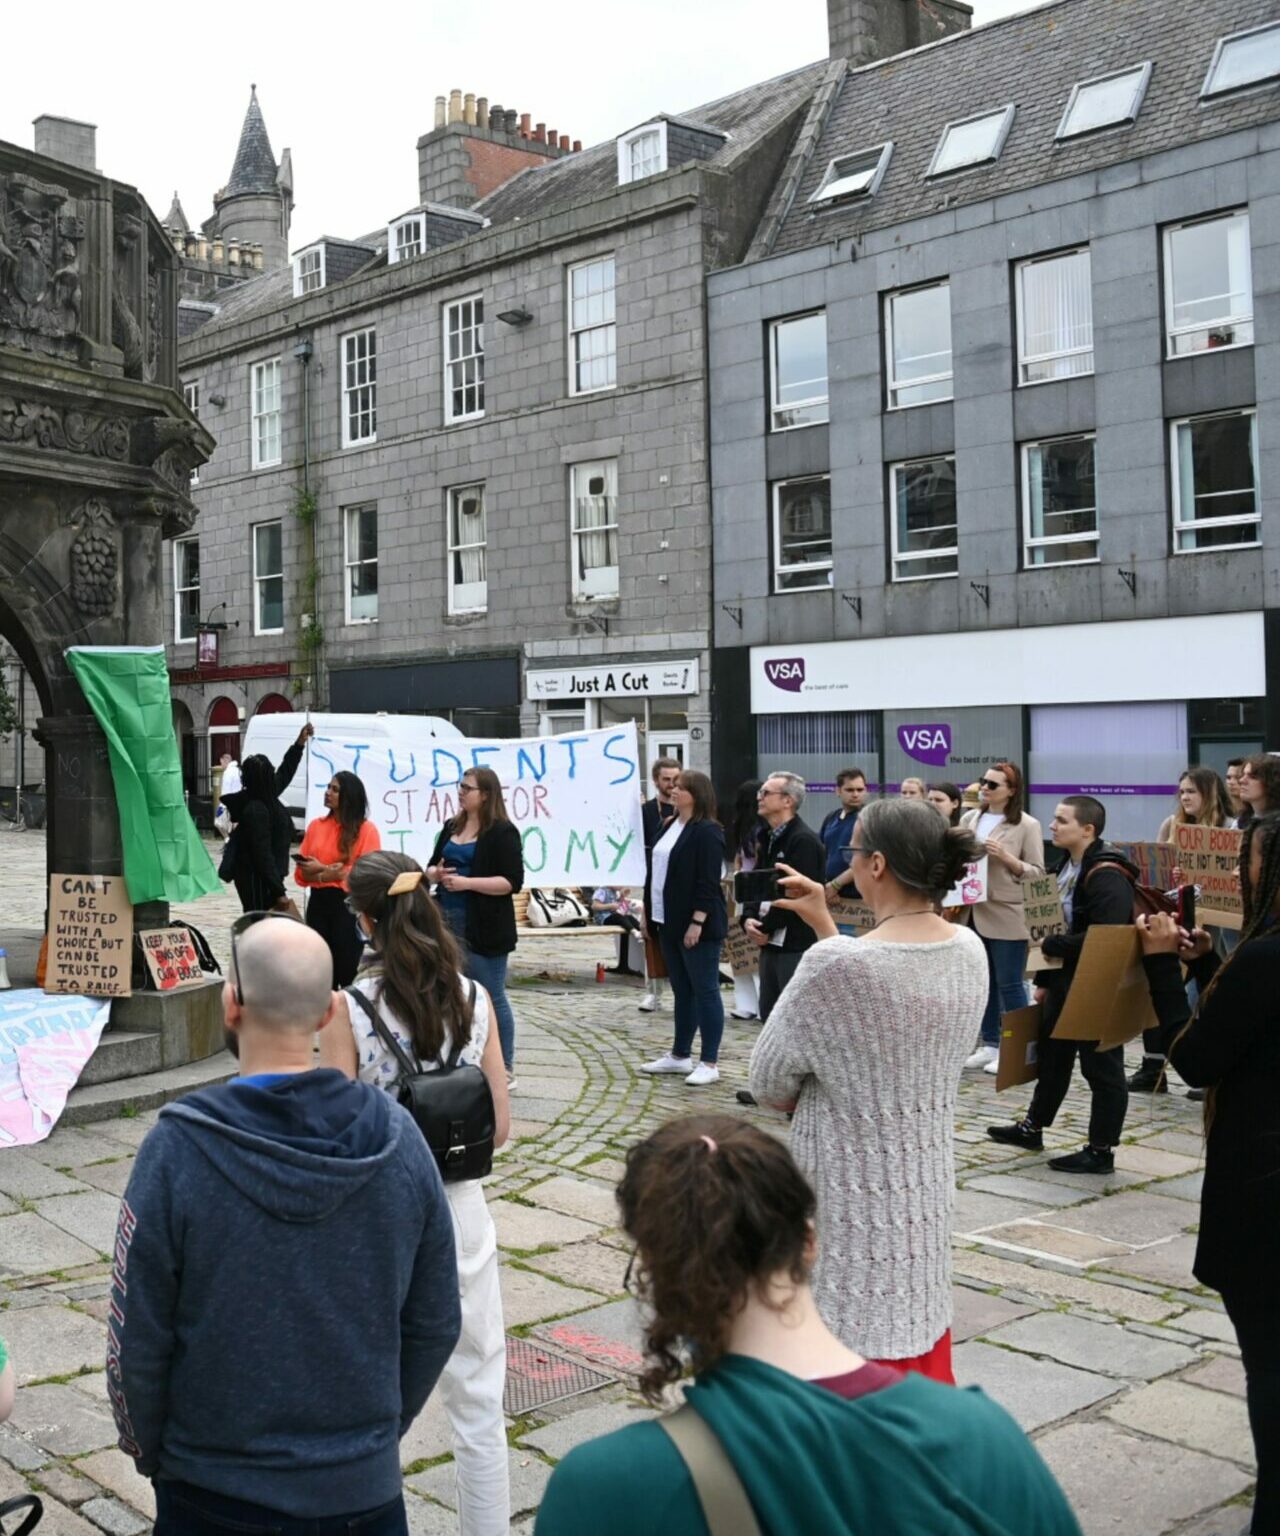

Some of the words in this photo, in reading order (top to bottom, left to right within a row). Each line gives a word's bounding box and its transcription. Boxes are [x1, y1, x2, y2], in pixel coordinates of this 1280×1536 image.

[769, 662, 803, 680] VSA
[569, 675, 599, 693] Just
[604, 673, 616, 691] A
[622, 672, 649, 690] Cut
[903, 729, 948, 750] VSA
[311, 734, 636, 787] STUDENTS
[383, 789, 457, 824] STAN
[1178, 827, 1203, 850] OUR
[1210, 830, 1238, 852] BODIE
[1178, 852, 1194, 869] ARE
[1196, 854, 1211, 869] NOT
[78, 897, 96, 909] BE
[60, 910, 117, 924] TRUSTED
[1024, 907, 1038, 918] THE
[57, 924, 88, 936] WITH
[93, 928, 102, 937] A
[1030, 922, 1062, 941] CHOICE
[56, 938, 97, 949] CHOICE
[101, 939, 123, 949] BUT
[145, 935, 162, 948] KEEP
[167, 933, 188, 945] YOUR
[57, 951, 82, 961] CAN
[86, 952, 99, 962] BE
[58, 964, 118, 978] TRUSTED
